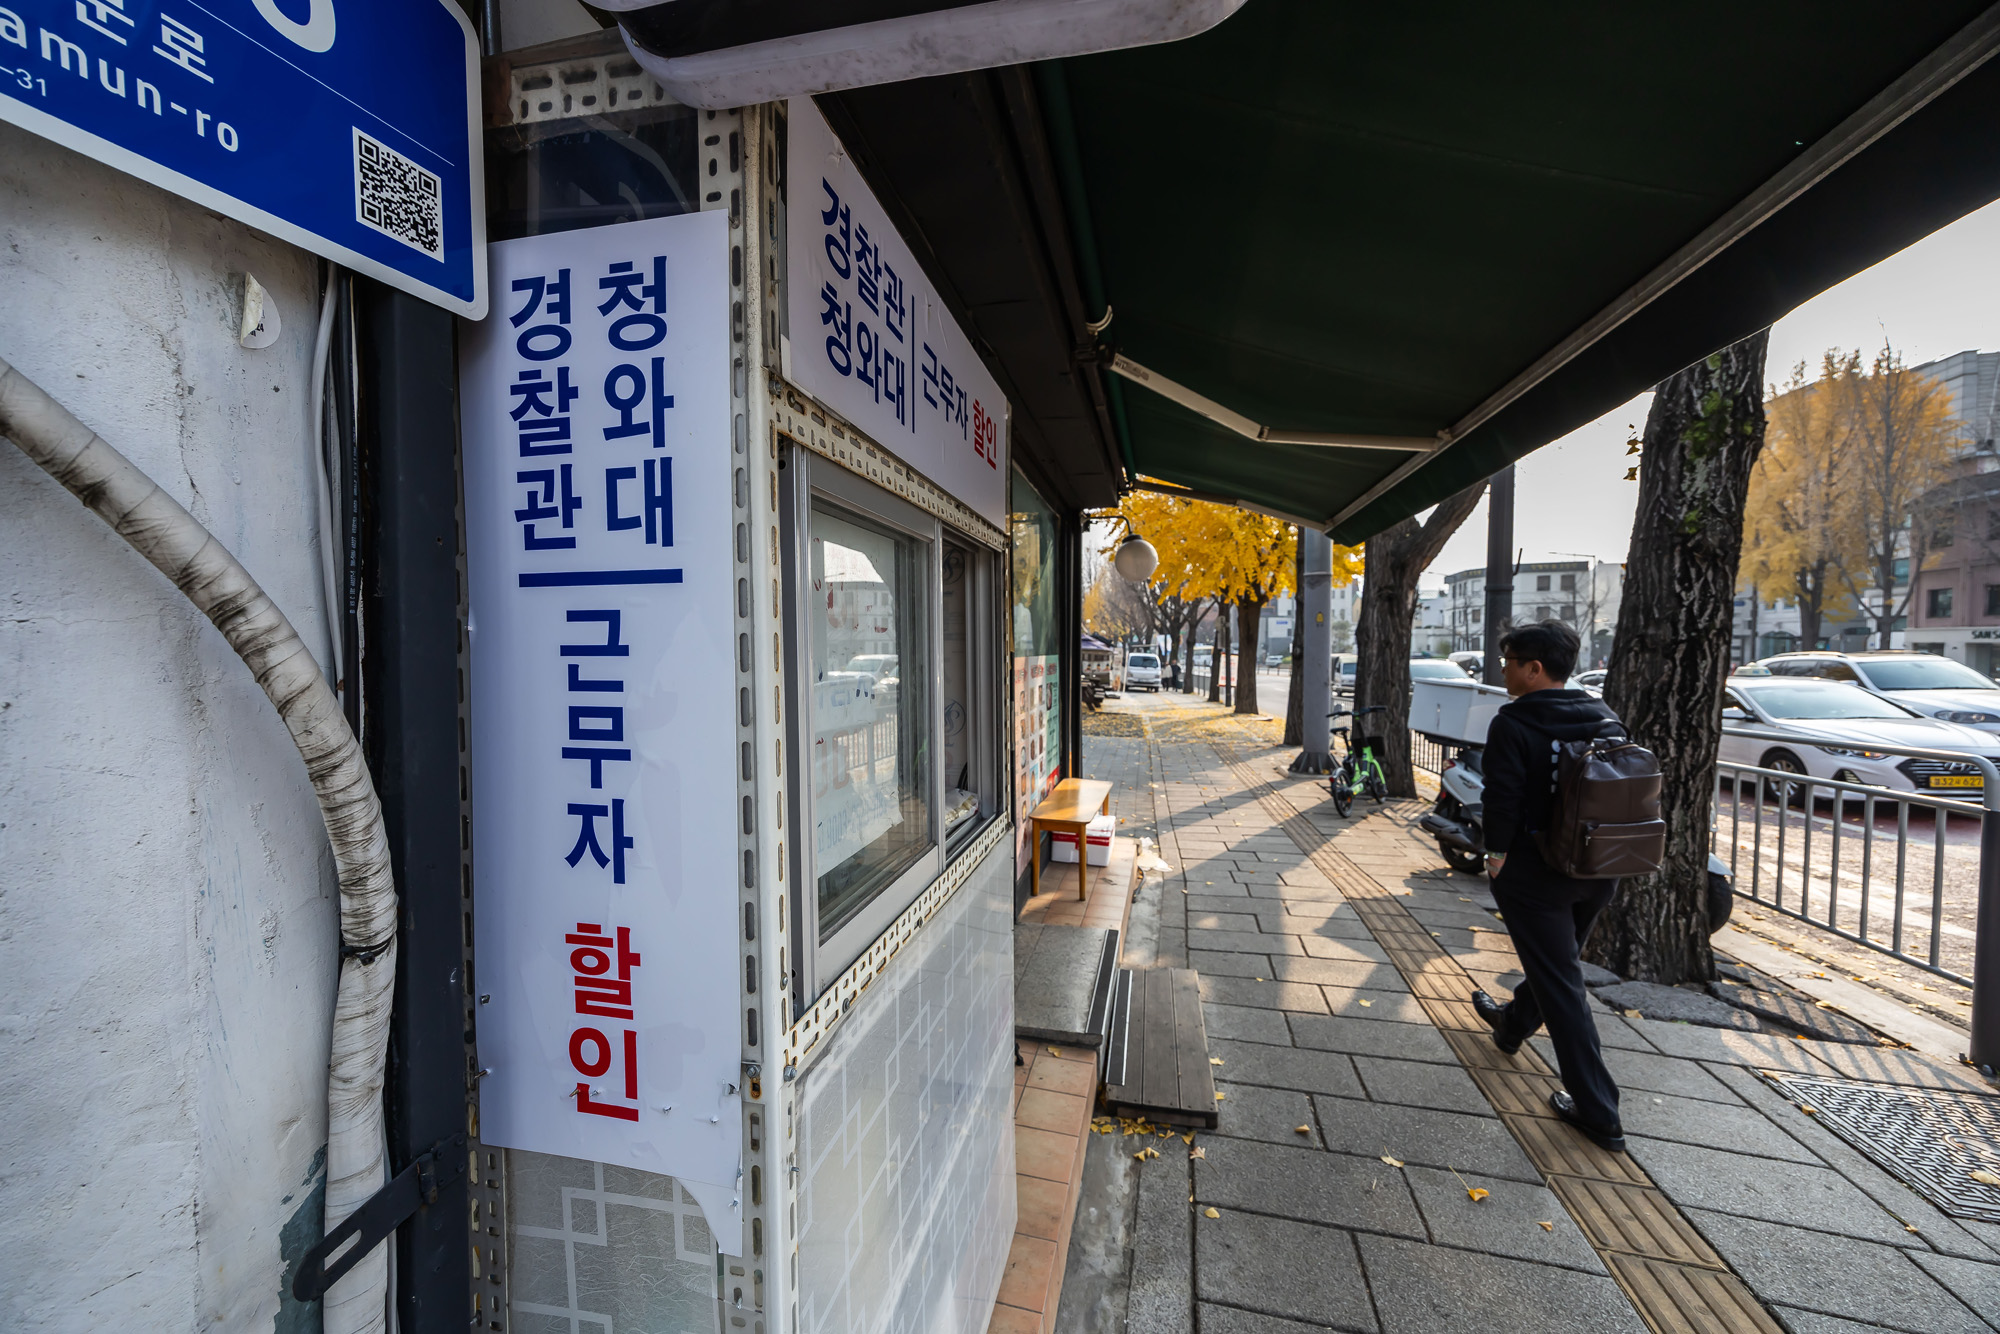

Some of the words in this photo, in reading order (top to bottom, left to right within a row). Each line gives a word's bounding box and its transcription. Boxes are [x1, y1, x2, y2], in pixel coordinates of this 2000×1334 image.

[820, 280, 905, 426] 청와대
[821, 176, 905, 344] 경찰관
[509, 268, 582, 551] 경찰관
[597, 255, 674, 547] 청와대
[921, 341, 968, 441] 근무자
[973, 399, 997, 470] 할인
[560, 609, 633, 884] 근무자
[565, 922, 641, 1122] 할인
